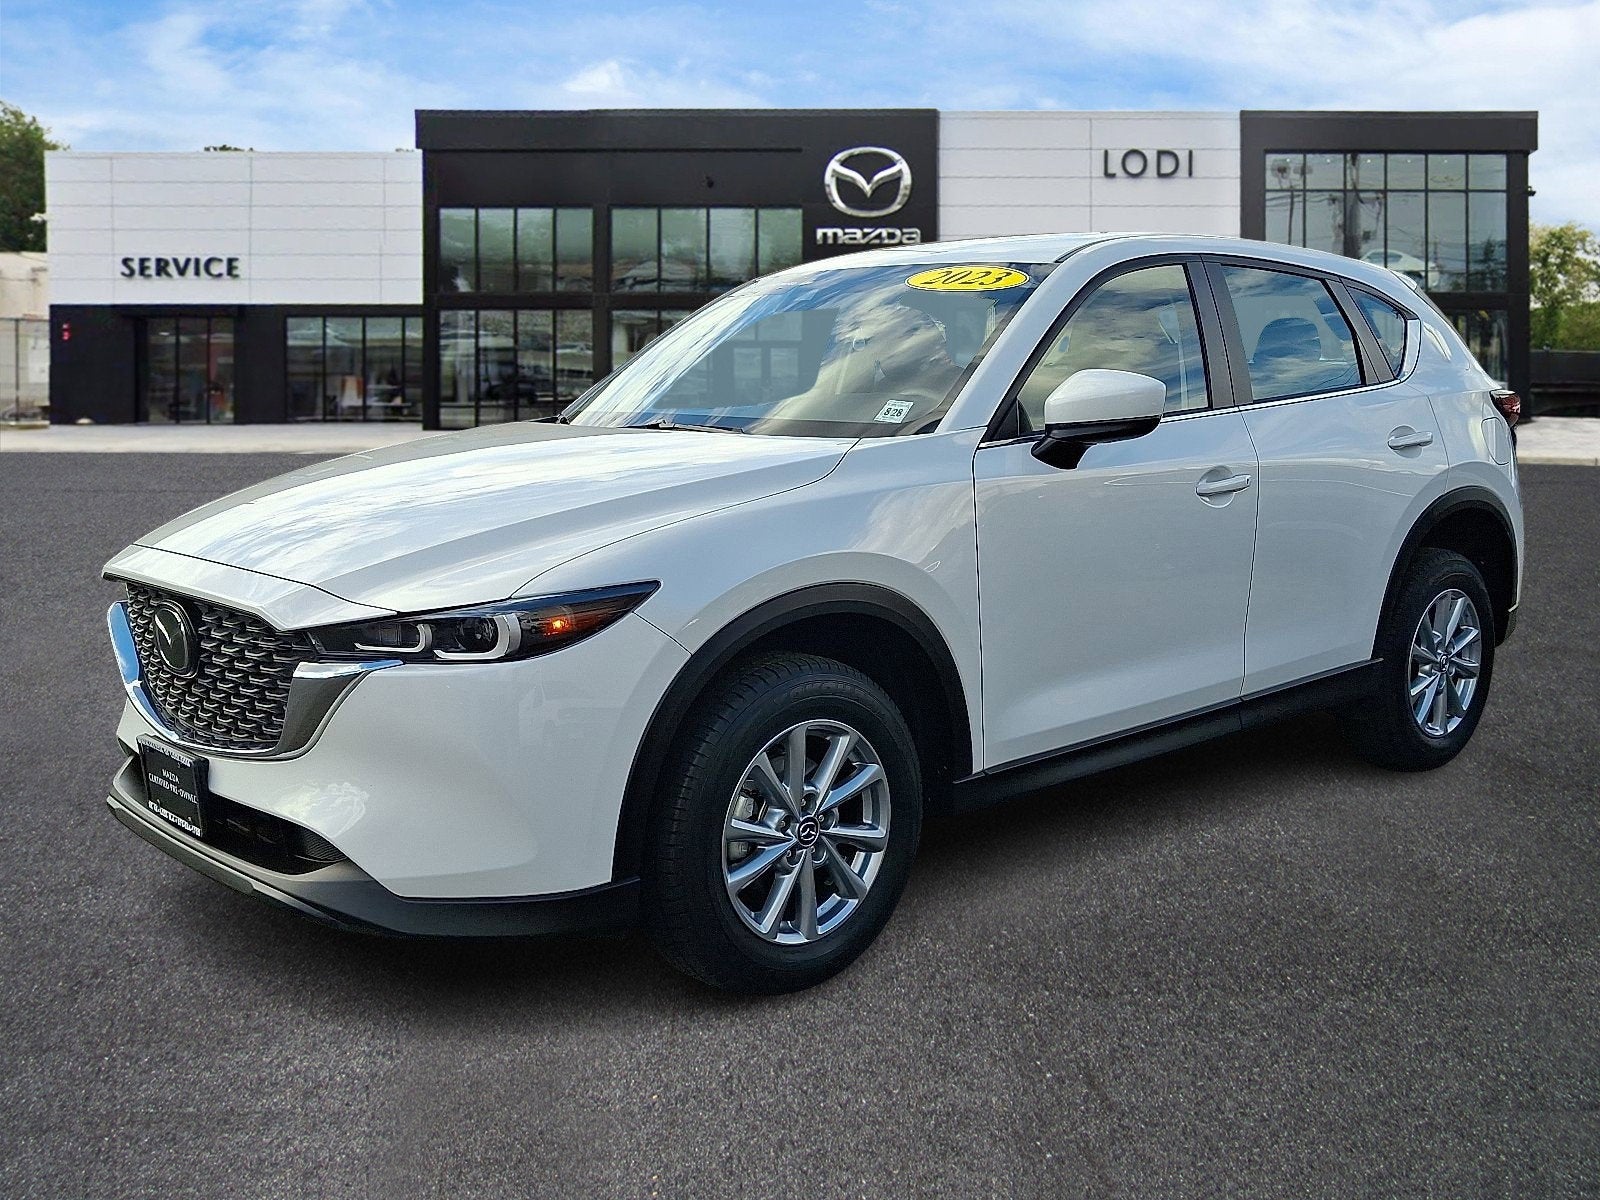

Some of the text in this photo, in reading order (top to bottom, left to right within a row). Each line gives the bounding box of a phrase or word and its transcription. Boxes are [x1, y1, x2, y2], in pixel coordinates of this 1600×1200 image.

[1103, 148, 1194, 179] LODI
[815, 227, 922, 245] mazda
[120, 256, 240, 279] SERVICE
[919, 269, 1013, 286] 2023
[162, 768, 179, 783] MAZDA
